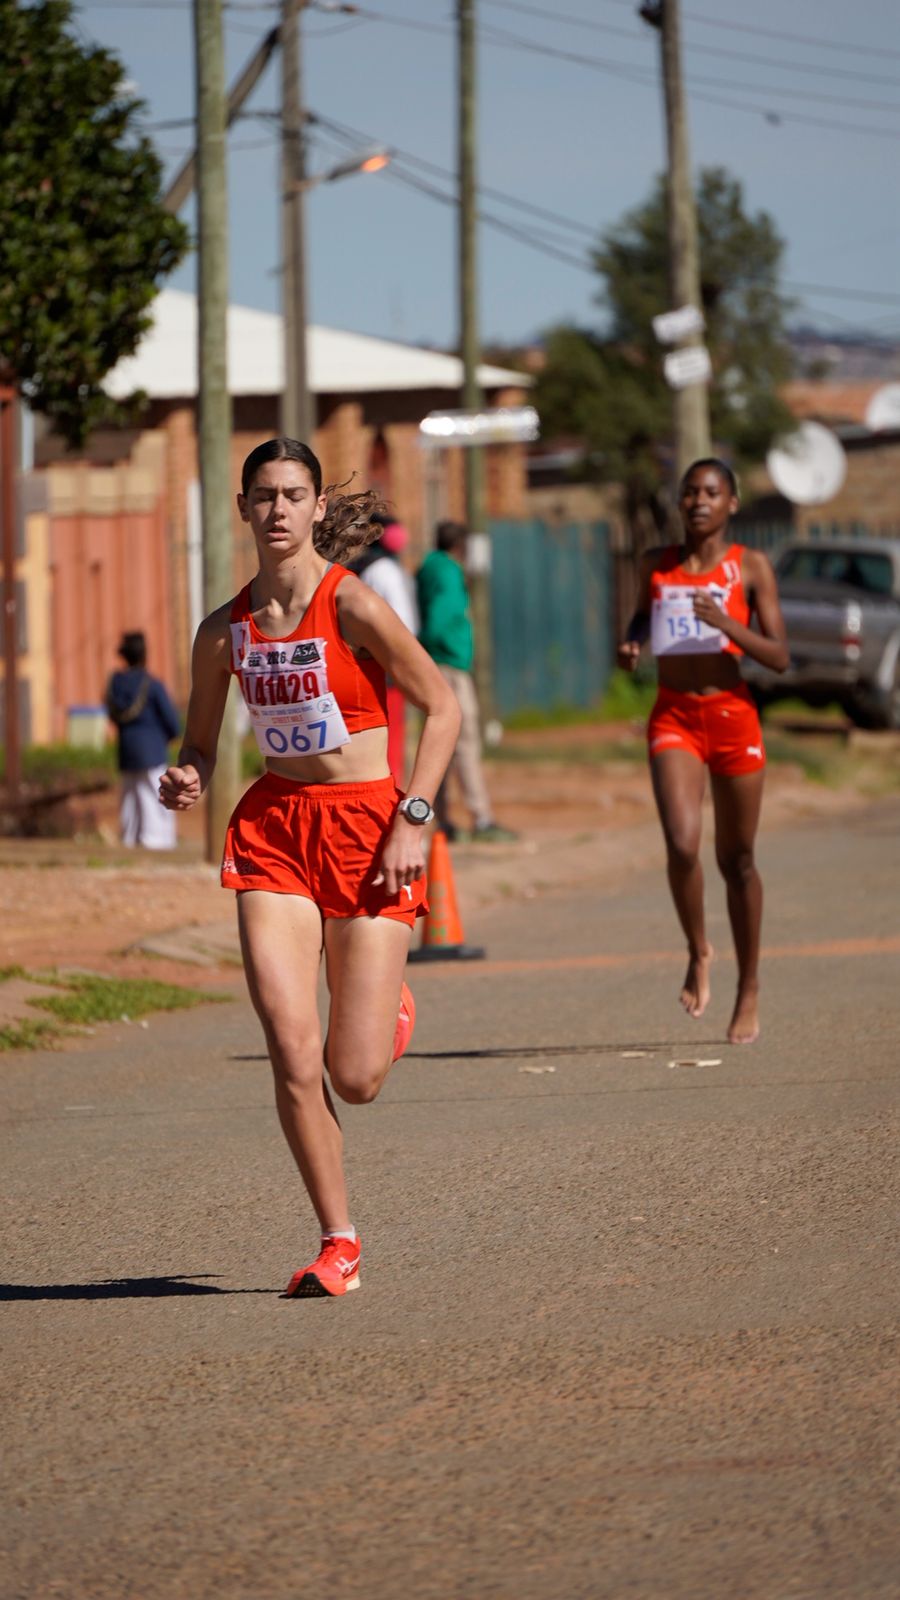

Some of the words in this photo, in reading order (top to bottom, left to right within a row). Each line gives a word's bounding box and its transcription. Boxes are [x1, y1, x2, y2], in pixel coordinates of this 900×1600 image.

[667, 616, 701, 638] 151
[295, 645, 317, 656] ASA
[265, 720, 327, 753] 067
